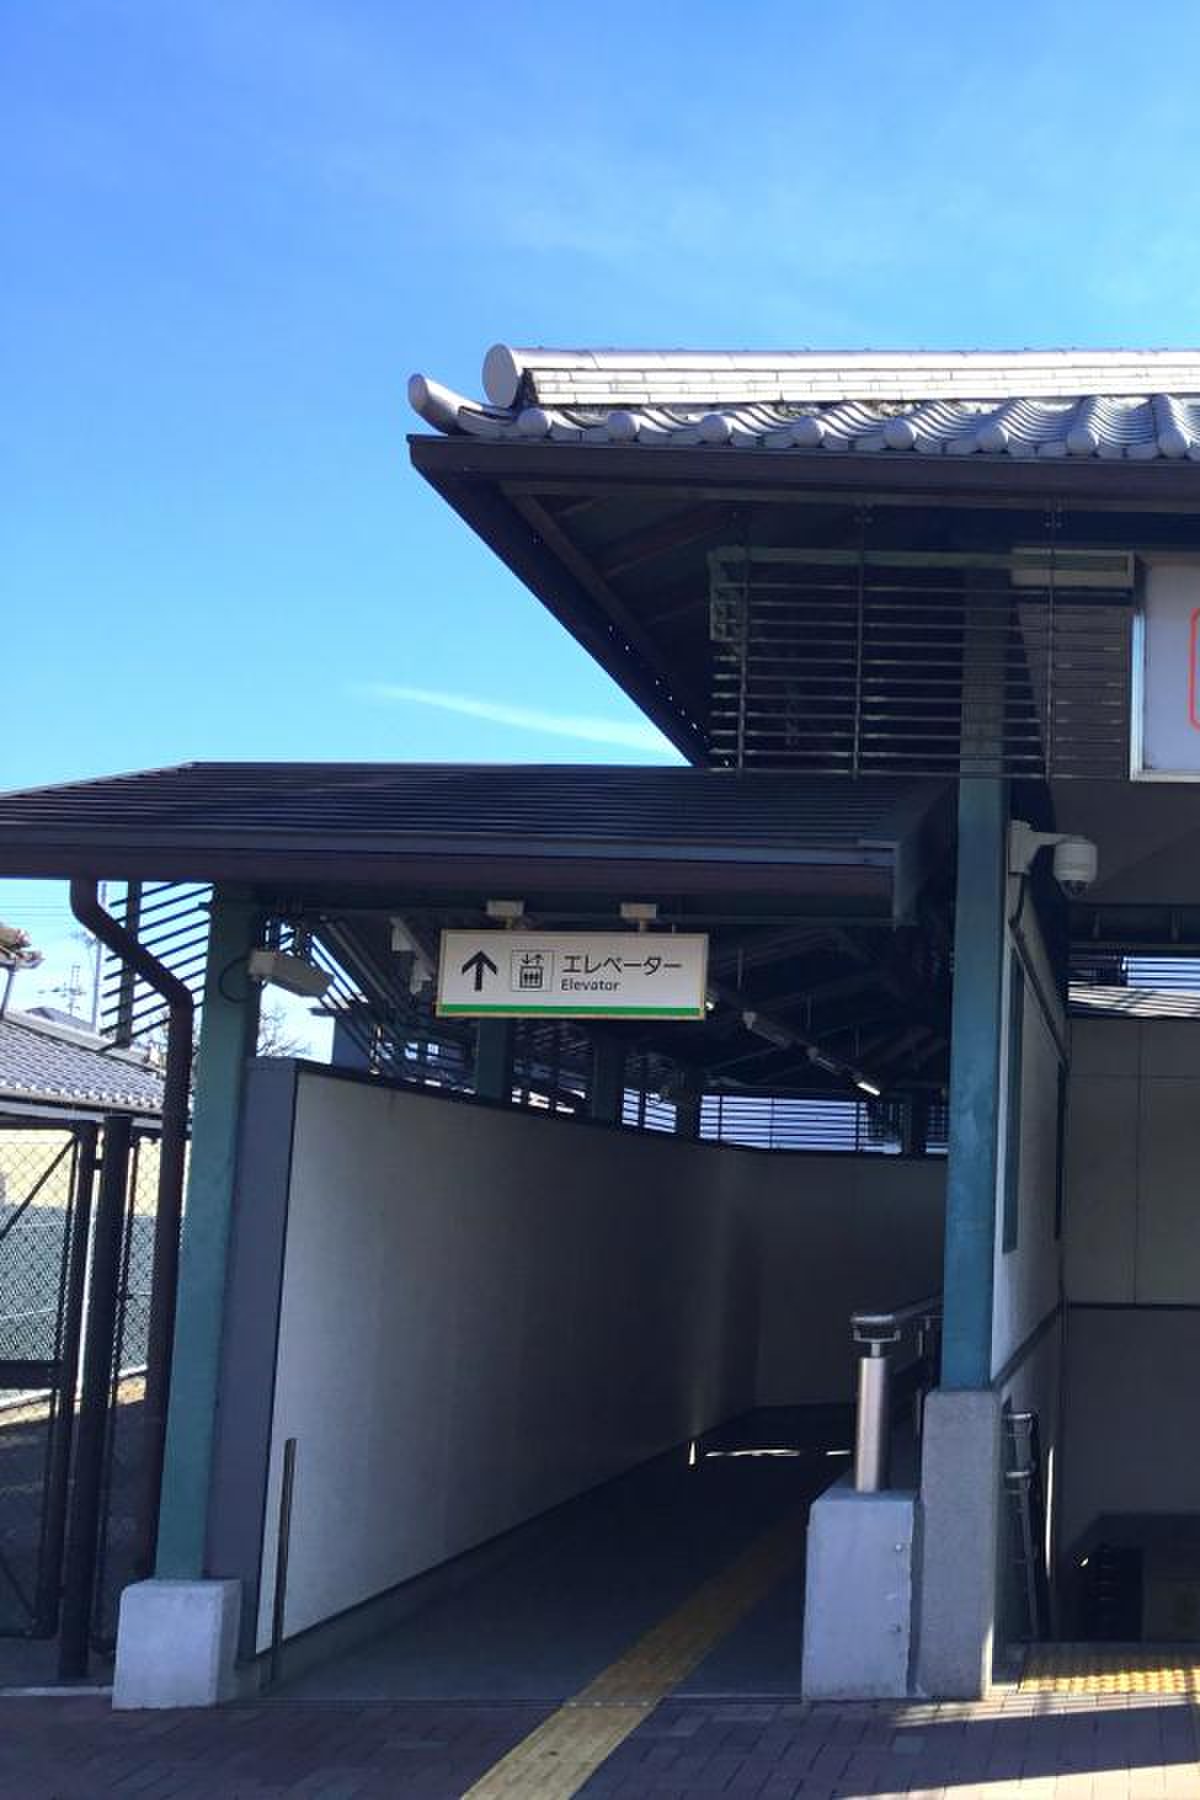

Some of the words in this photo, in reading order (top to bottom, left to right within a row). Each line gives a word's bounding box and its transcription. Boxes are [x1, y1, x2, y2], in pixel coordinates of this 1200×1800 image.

[562, 954, 683, 976] エレベーター
[560, 977, 621, 992] Elevator
